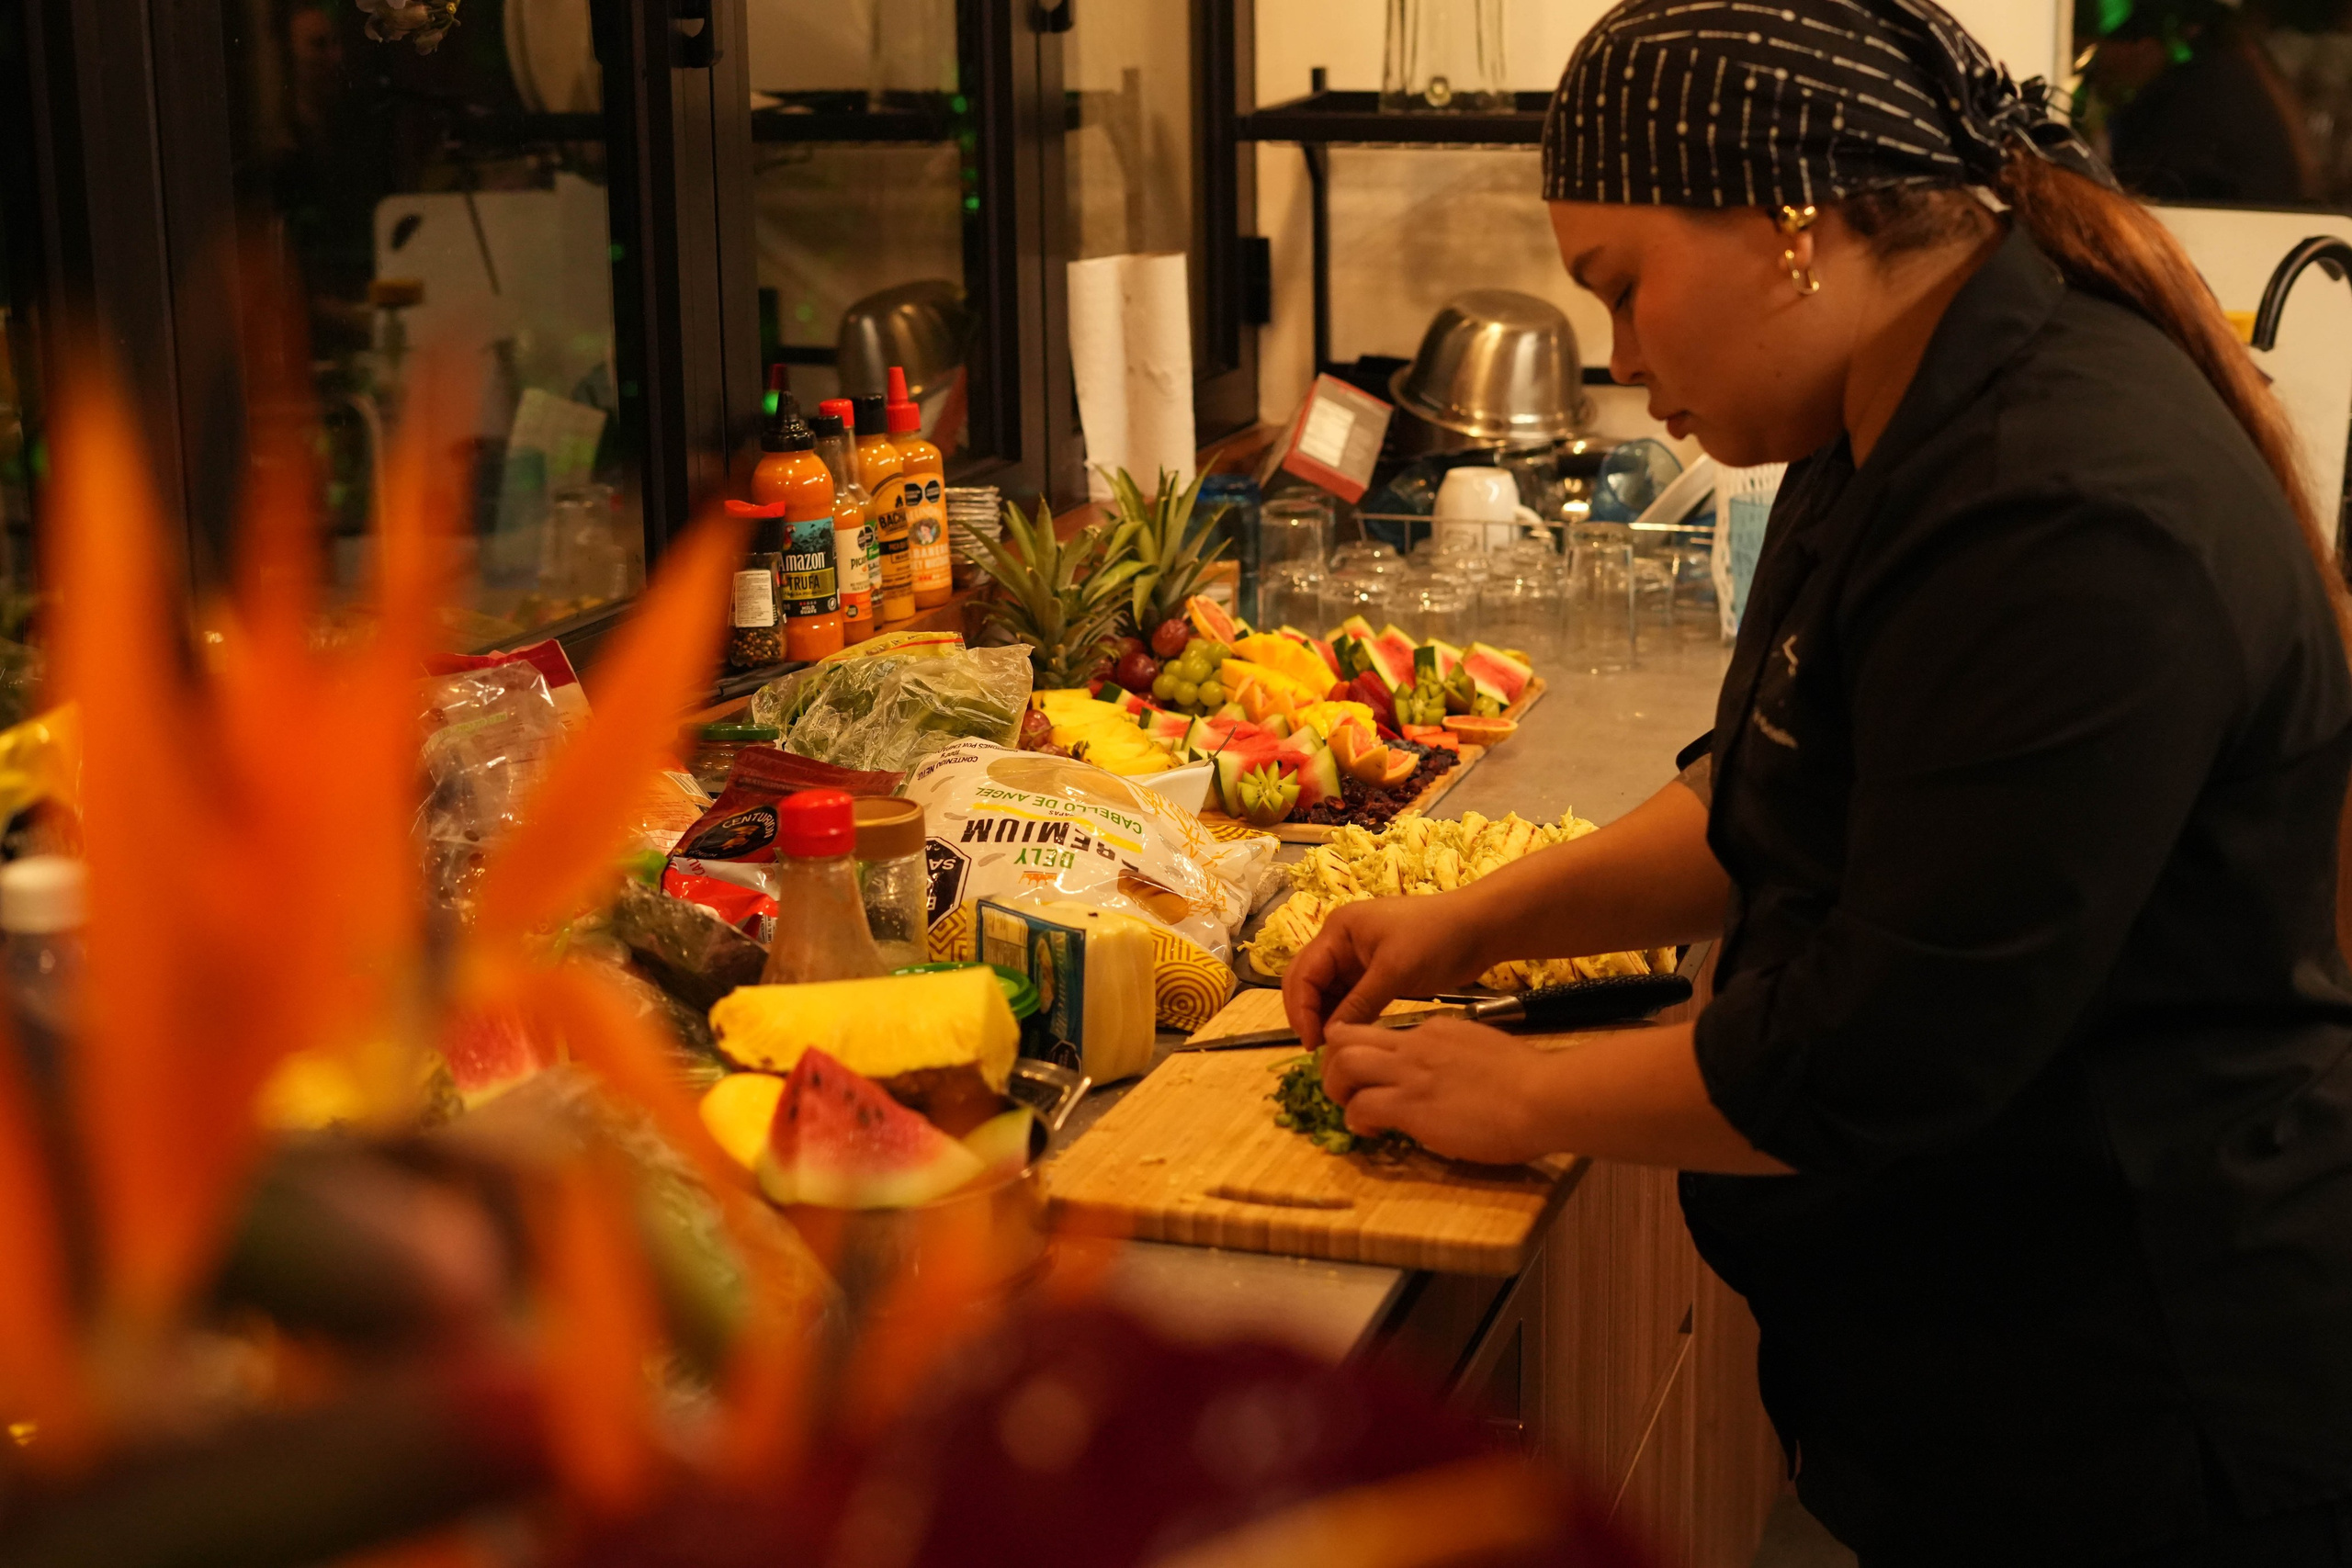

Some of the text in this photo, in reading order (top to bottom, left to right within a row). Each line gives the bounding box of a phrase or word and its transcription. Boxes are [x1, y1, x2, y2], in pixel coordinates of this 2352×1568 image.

[787, 575, 820, 591] TRUFA
[975, 786, 1143, 834] CABELLO DE ANGEL
[722, 812, 775, 839] CENTURION
[1013, 847, 1075, 869] DELY
